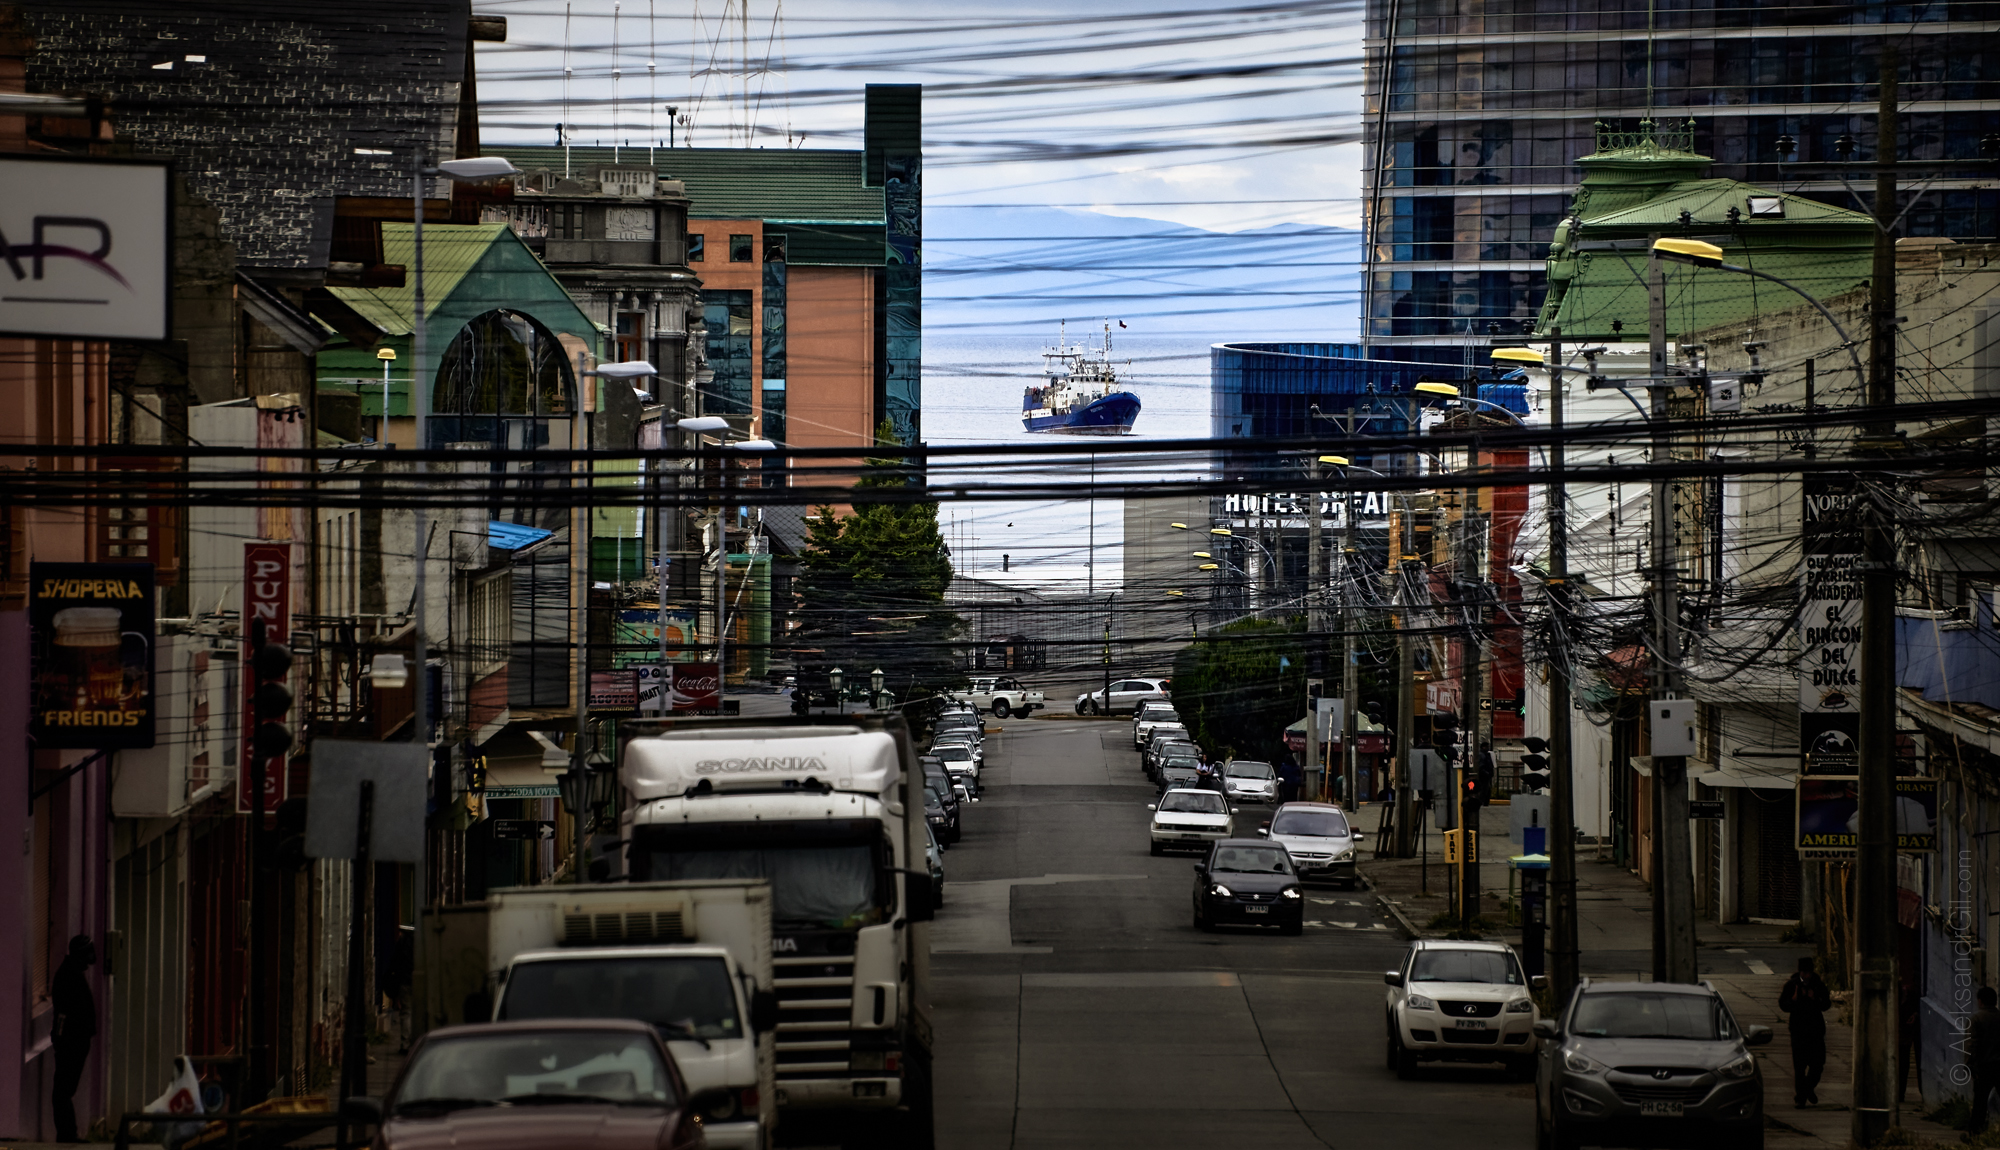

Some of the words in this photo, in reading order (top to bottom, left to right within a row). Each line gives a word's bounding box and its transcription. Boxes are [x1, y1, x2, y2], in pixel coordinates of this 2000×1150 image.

[37, 578, 144, 599] SHOPERIA
[1825, 605, 1842, 622] EL
[1806, 626, 1862, 644] RINCON
[1822, 647, 1847, 665] DEL
[1813, 668, 1856, 687] DULCE
[695, 757, 827, 774] SCANIA
[1897, 835, 1932, 848] BAY
